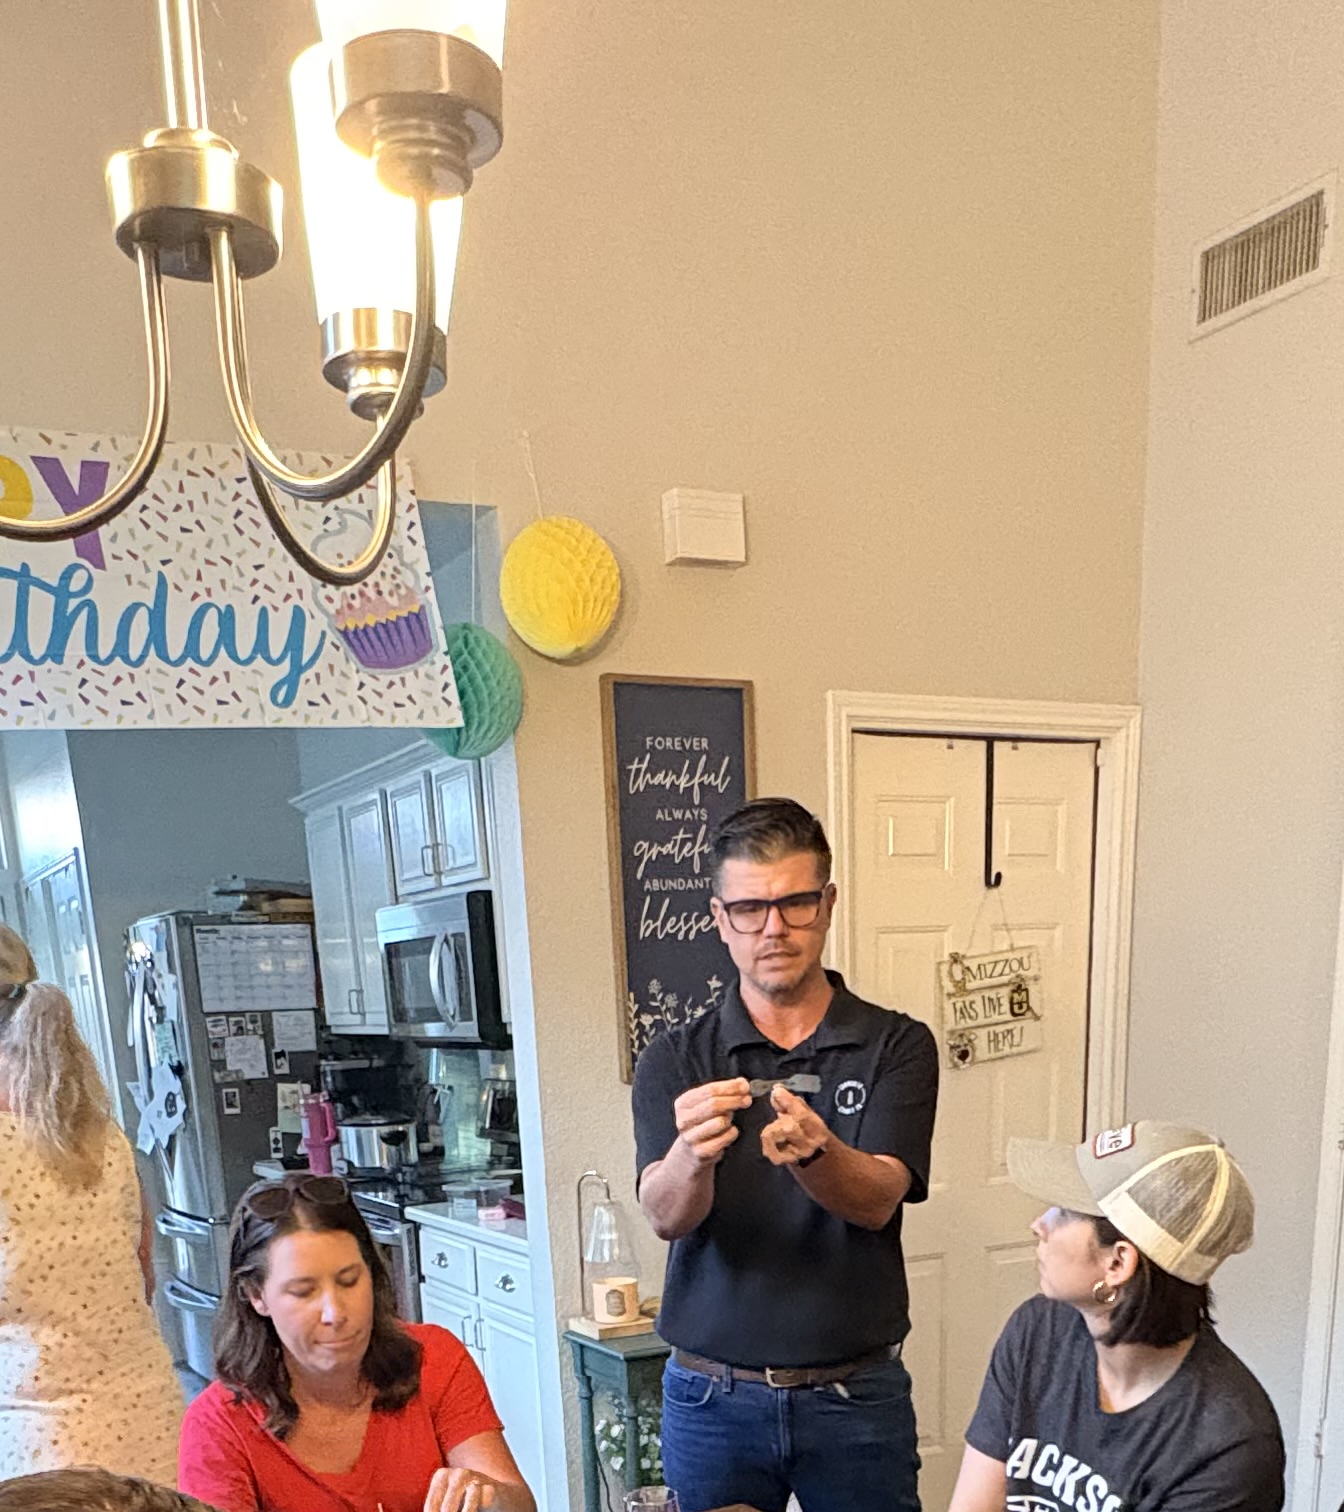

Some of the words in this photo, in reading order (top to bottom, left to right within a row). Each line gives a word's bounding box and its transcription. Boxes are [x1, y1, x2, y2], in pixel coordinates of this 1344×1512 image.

[645, 736, 709, 751] FOREVER
[626, 752, 731, 805] thankful
[656, 807, 708, 821] ALWAYS
[633, 823, 711, 880] gratef
[644, 877, 712, 892] ABUNDANT
[640, 894, 718, 941] blesse
[965, 953, 1033, 983] MIZZOU
[981, 993, 1008, 1019] LIVE
